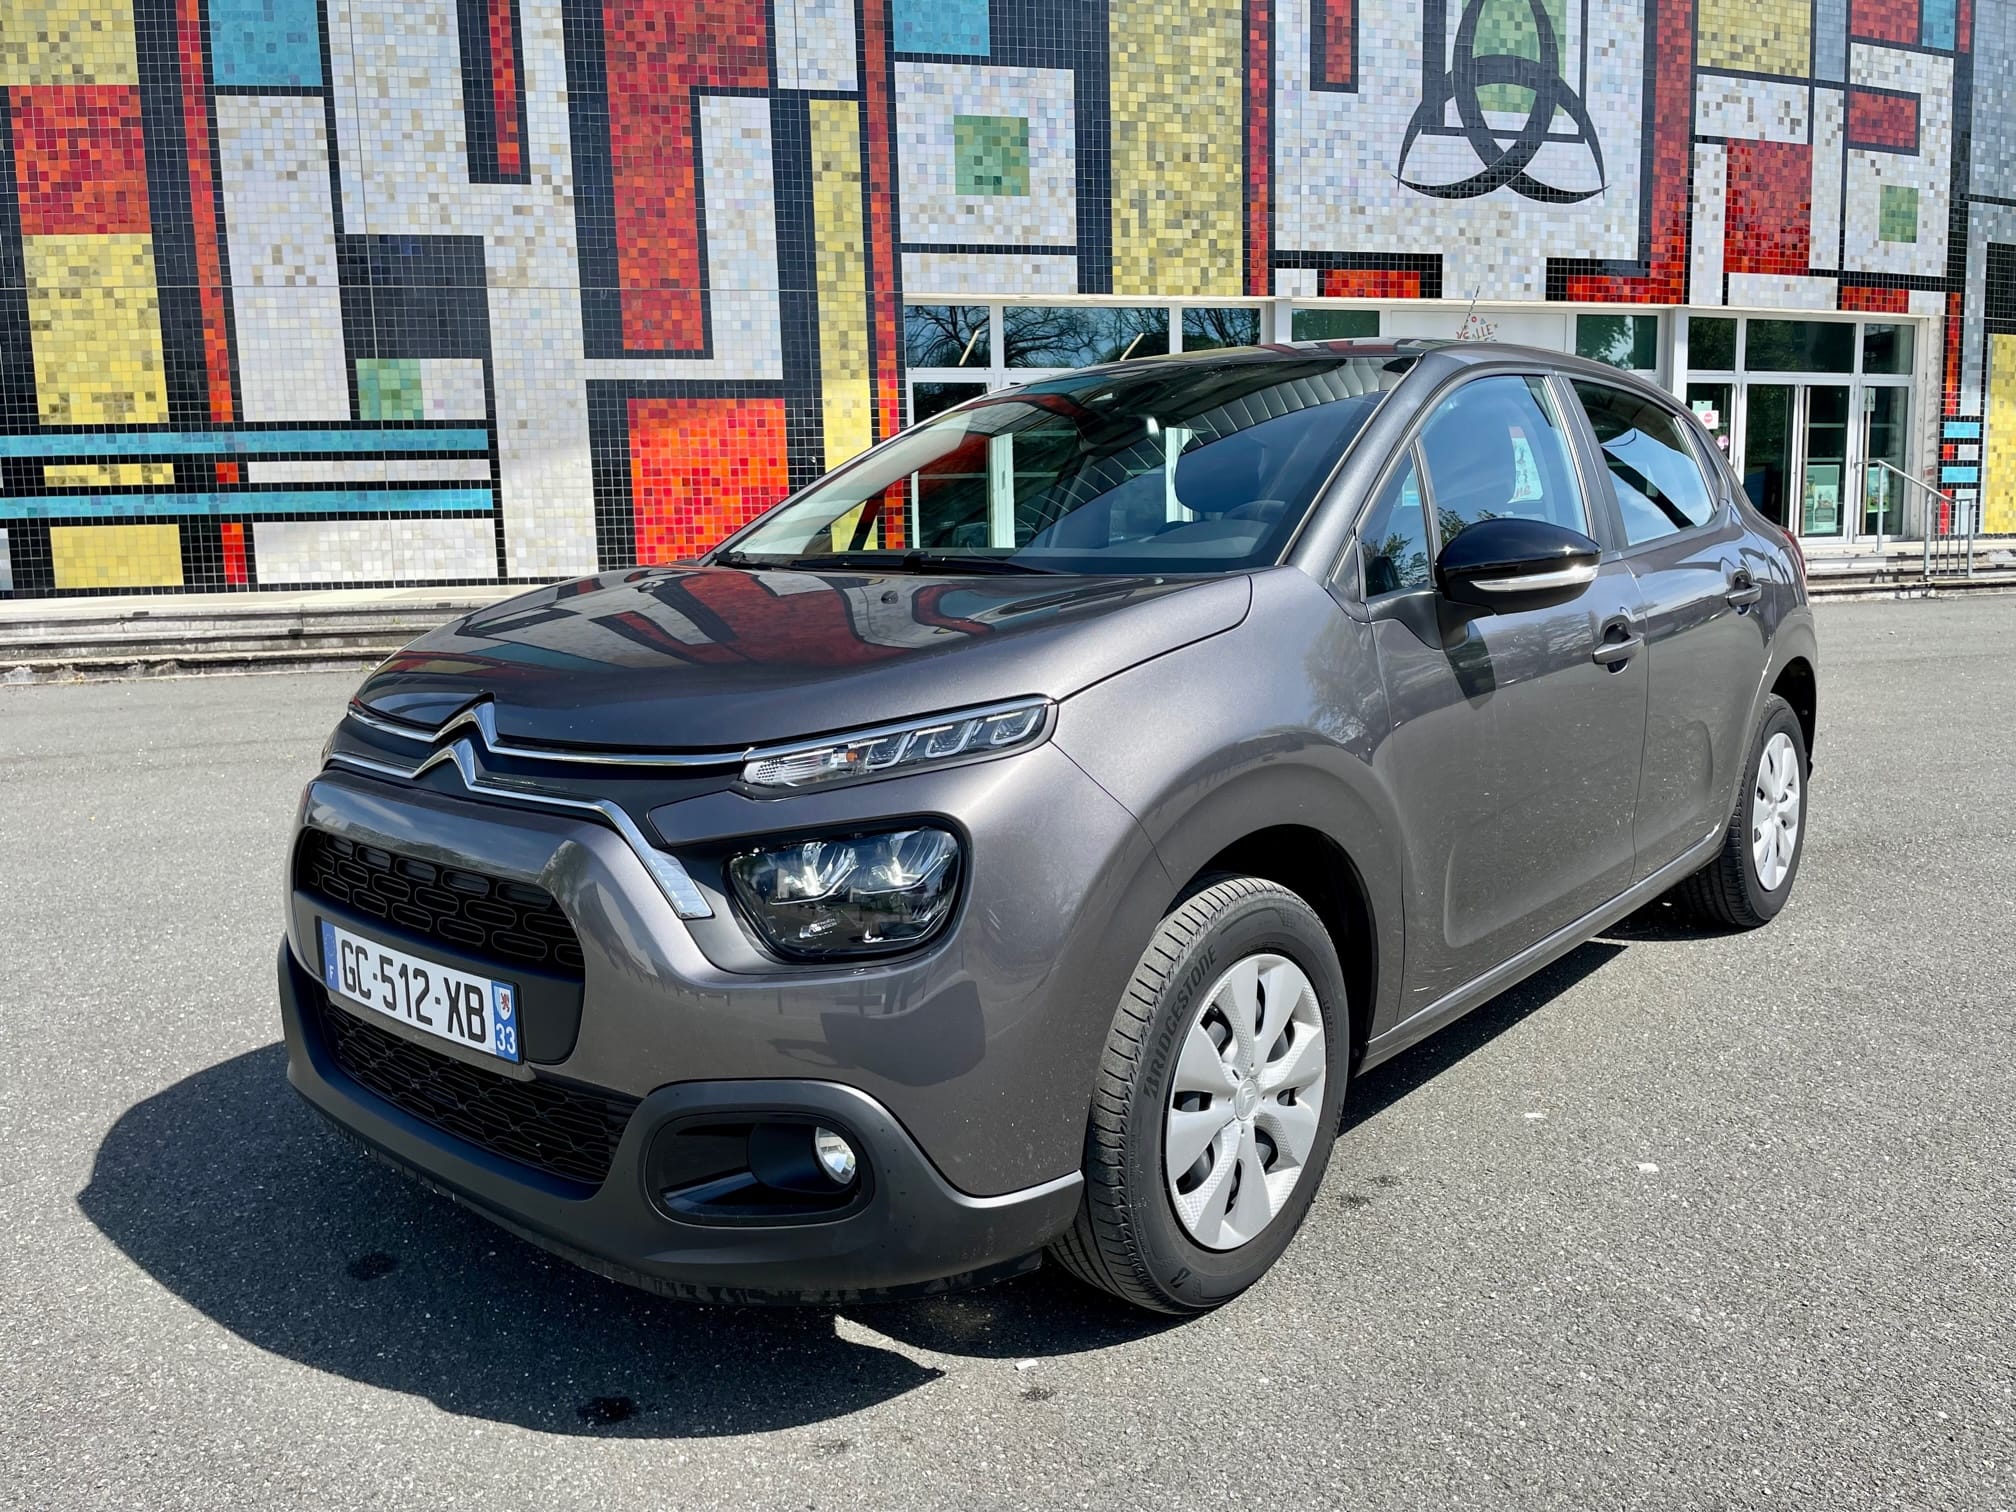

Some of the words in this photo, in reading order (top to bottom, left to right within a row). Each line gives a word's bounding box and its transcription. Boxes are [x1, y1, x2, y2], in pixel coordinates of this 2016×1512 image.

[328, 965, 335, 980] F
[341, 938, 487, 1044] GC-512-XB
[495, 1023, 516, 1055] 33
[1143, 944, 1217, 1099] BRIDGESTONE
